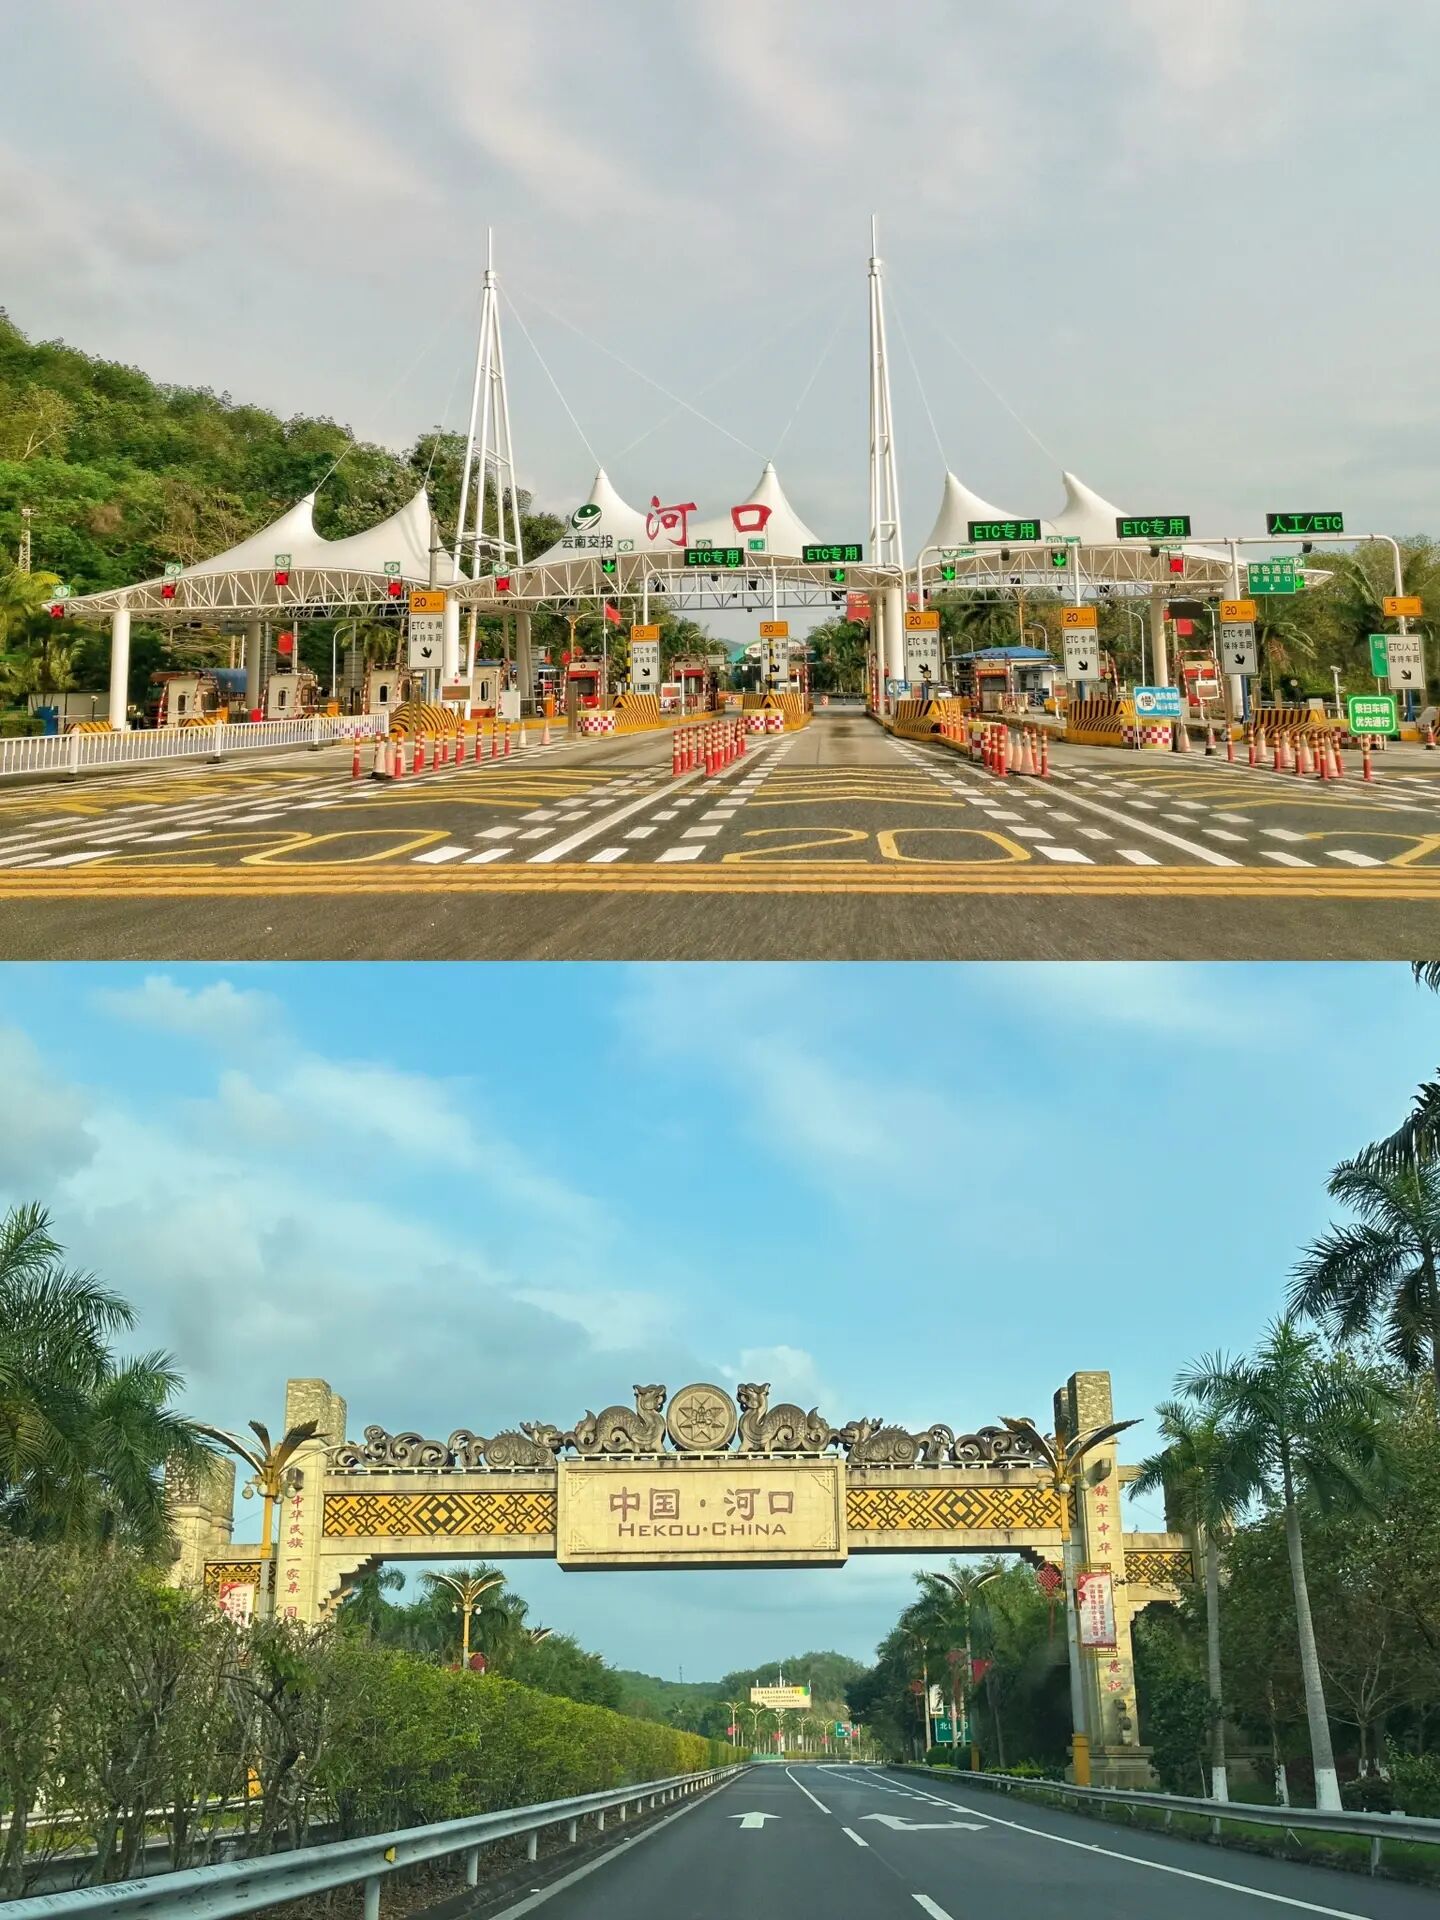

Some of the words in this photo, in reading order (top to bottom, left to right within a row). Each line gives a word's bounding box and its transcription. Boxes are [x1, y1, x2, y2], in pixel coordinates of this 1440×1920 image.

[646, 495, 773, 547] 河口
[1122, 519, 1184, 535] ETC专用
[1271, 516, 1342, 532] 人工/ETC
[973, 522, 1035, 540] ETC专用
[561, 535, 613, 549] 云南交投
[688, 550, 739, 564] ETC专用
[807, 546, 857, 561] ETC专用
[413, 597, 427, 607] 20
[1224, 605, 1237, 615] 20
[909, 616, 922, 625] 20
[1065, 613, 1078, 622] 20
[634, 629, 645, 637] 20
[763, 624, 774, 633] 20
[1356, 716, 1391, 728] 优先通行
[722, 827, 1032, 864] 20
[286, 1494, 305, 1594] 中华民族一家亲
